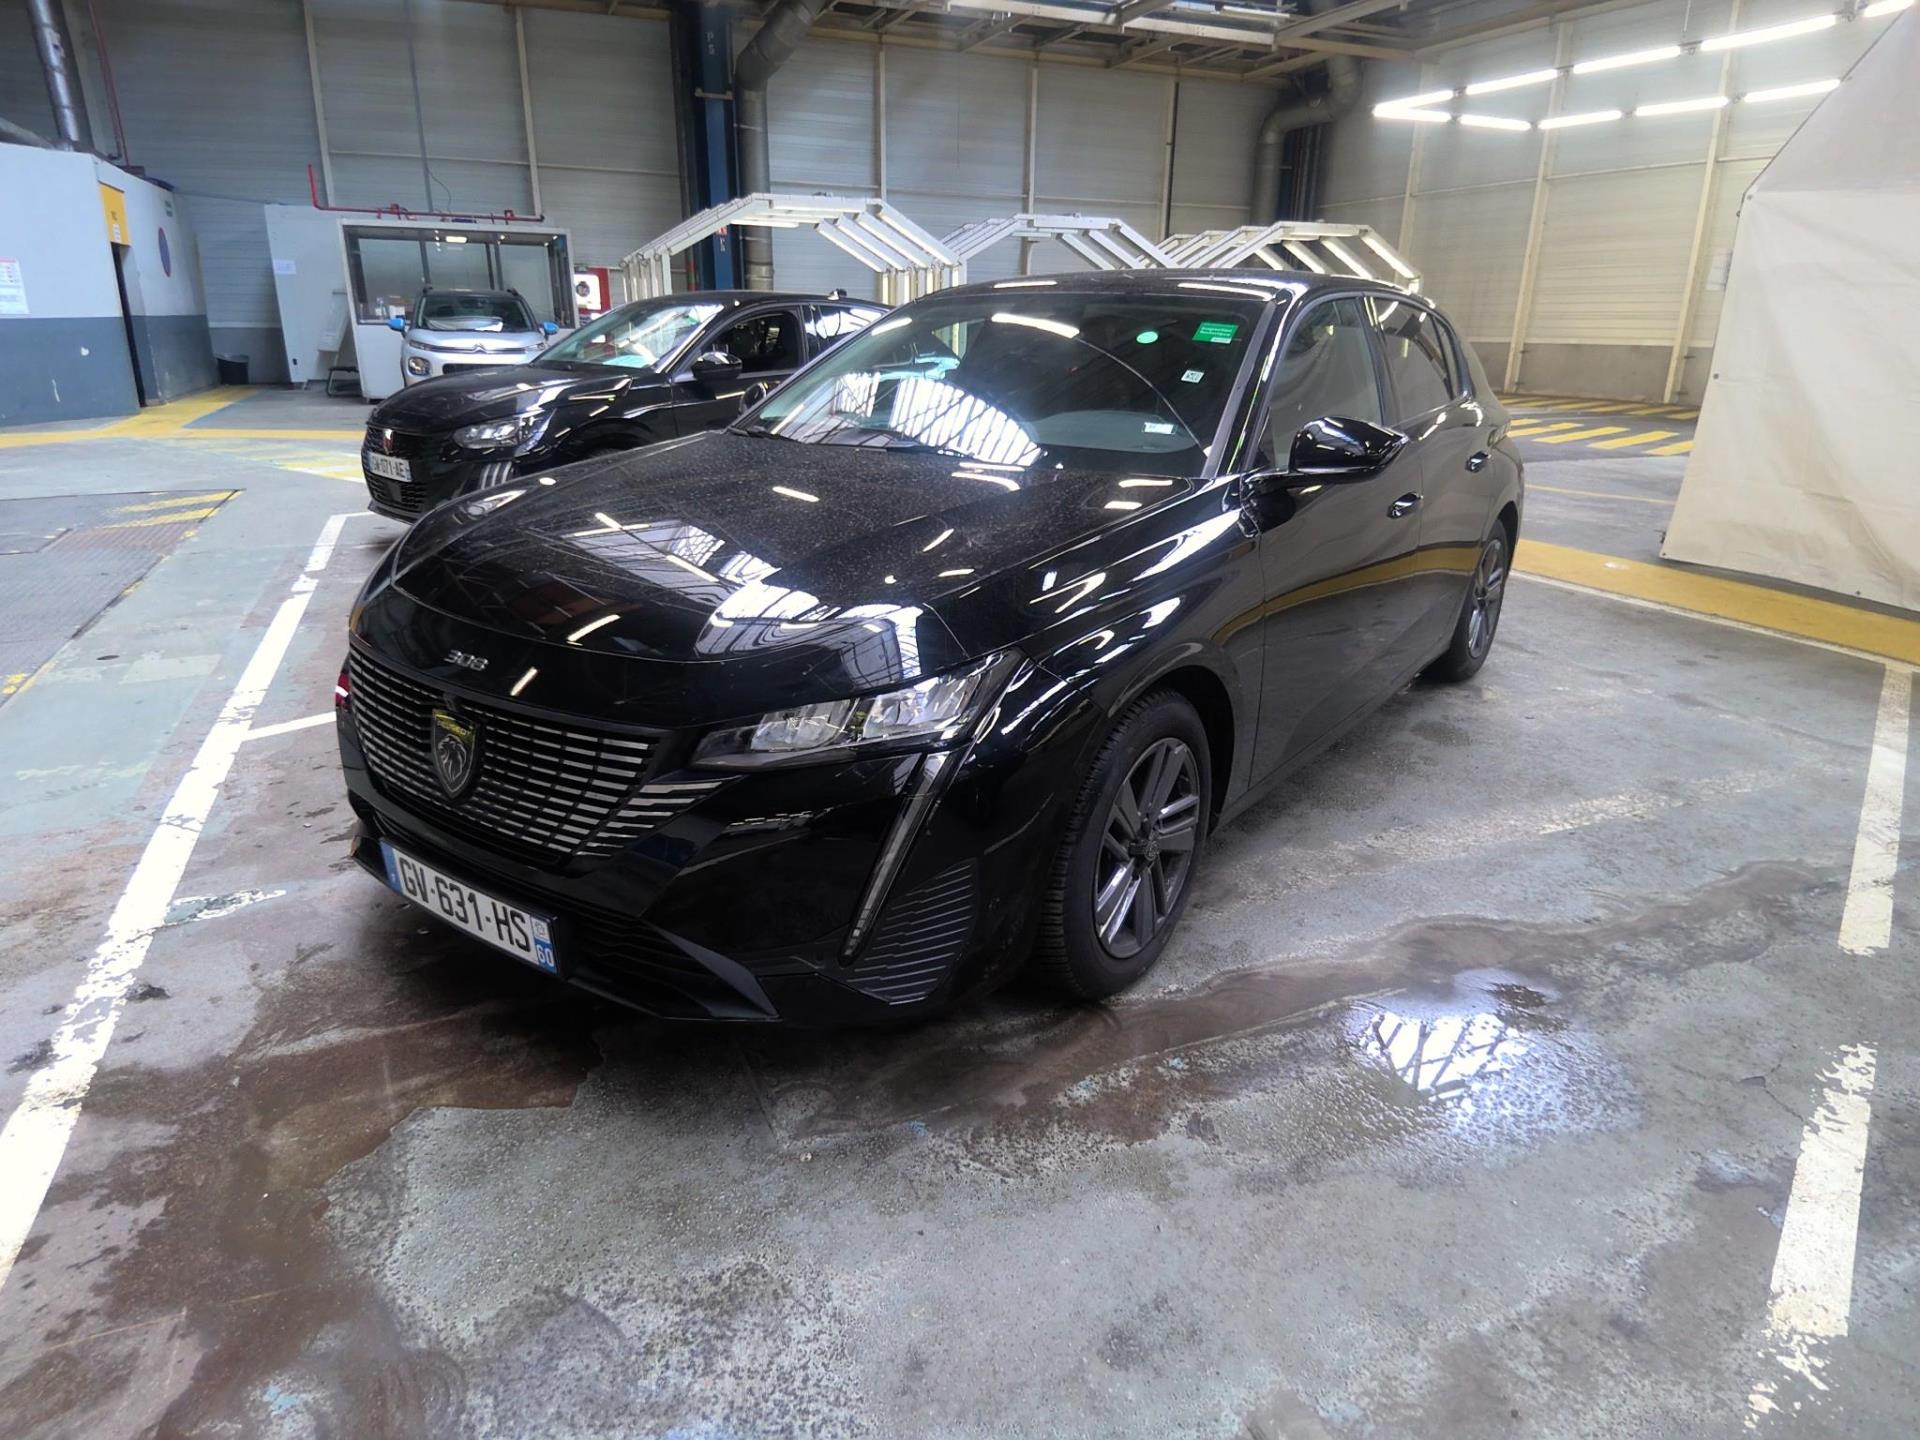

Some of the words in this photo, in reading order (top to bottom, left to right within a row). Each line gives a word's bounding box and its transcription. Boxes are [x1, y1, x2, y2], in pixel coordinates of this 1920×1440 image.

[444, 649, 489, 671] 308
[400, 857, 531, 952] GV-631-HS
[536, 944, 555, 967] 60
